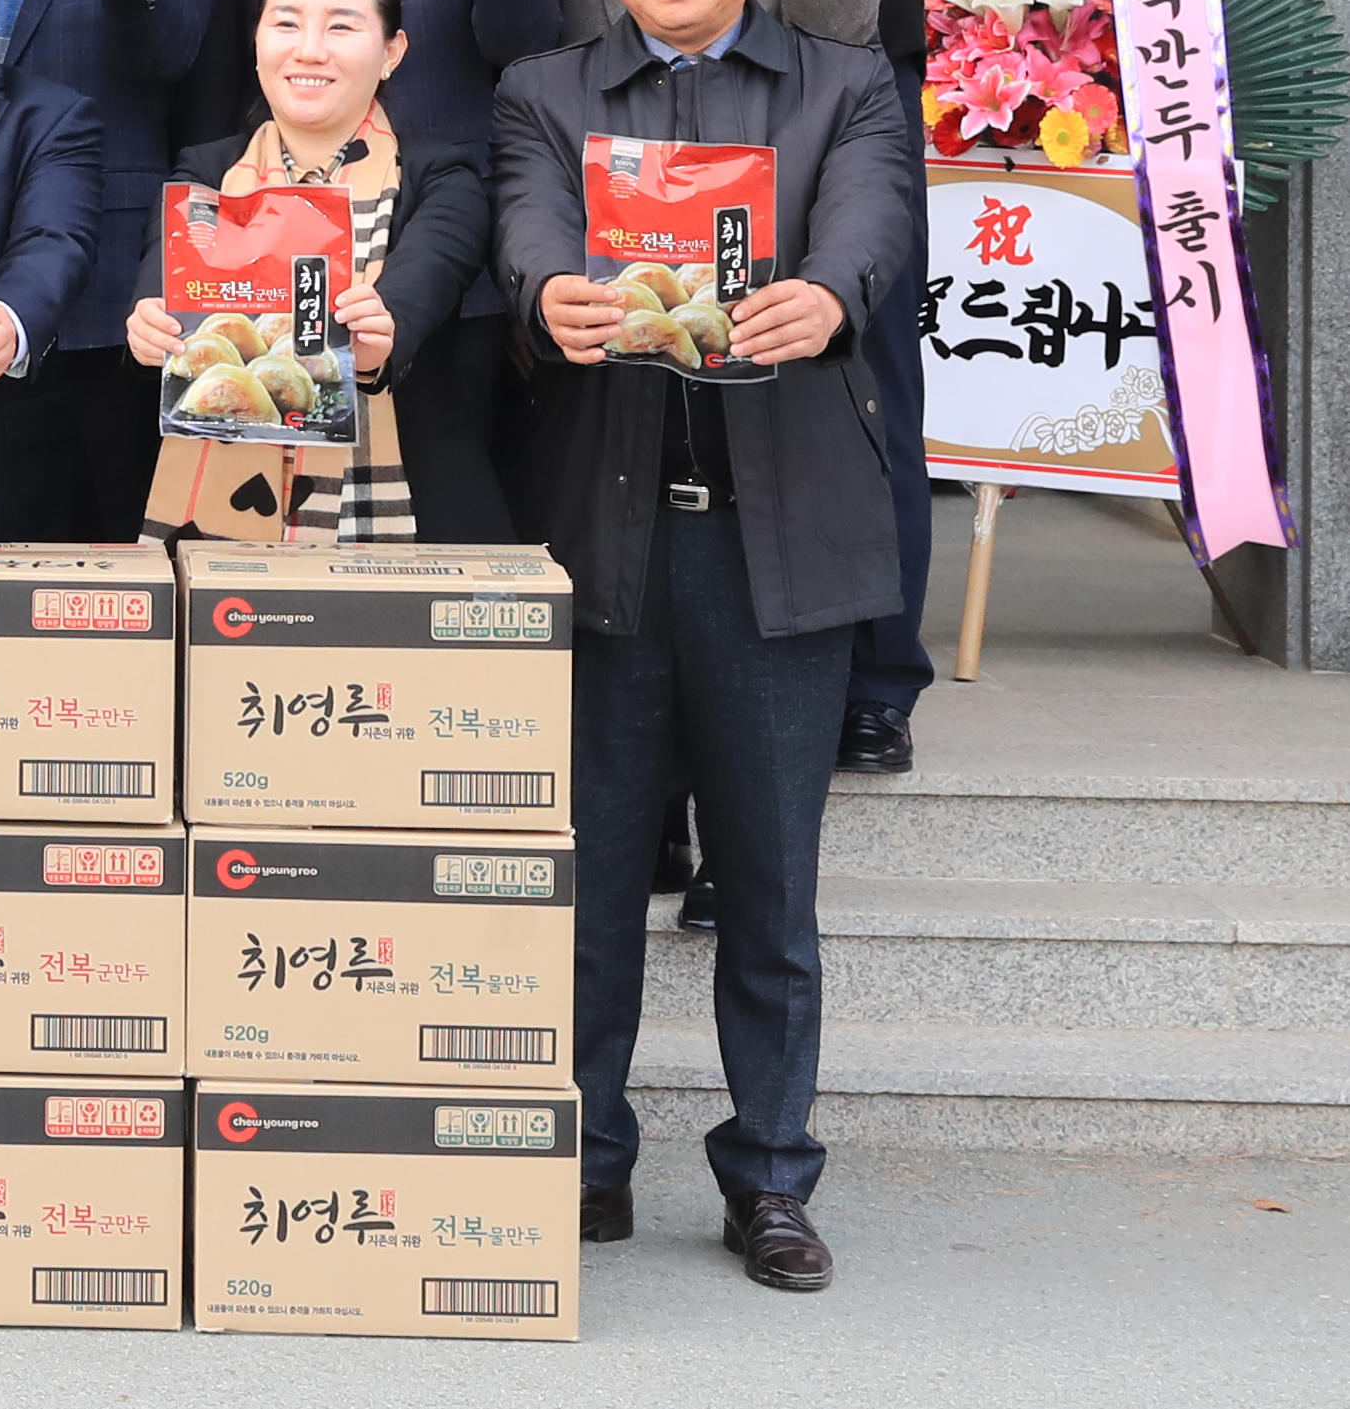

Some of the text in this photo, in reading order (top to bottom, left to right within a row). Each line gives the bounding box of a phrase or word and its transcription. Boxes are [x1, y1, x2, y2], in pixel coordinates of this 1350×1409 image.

[607, 228, 712, 252] 완도전복군만두
[963, 194, 1035, 266] 祝
[721, 216, 745, 295] 취영루
[1156, 190, 1222, 325] 출시
[186, 280, 290, 302] 완도전복군만두
[298, 265, 321, 347] 취영루
[228, 612, 315, 625] chew young roo
[28, 697, 137, 728] 전복군만두
[238, 682, 391, 738] 취영루
[429, 707, 539, 738] 전복물만두
[224, 772, 268, 789] 520g
[40, 952, 148, 983] 전복군만두
[238, 933, 395, 993] 취영루
[430, 963, 540, 995] 전복물만두
[232, 1118, 319, 1130] chew young roo
[42, 1204, 150, 1235] 전복군만두
[240, 1187, 395, 1246] 취영루
[432, 1215, 541, 1247] 전복물만두
[367, 1234, 421, 1248] 지존의 귀환
[227, 1280, 271, 1297] 520g
